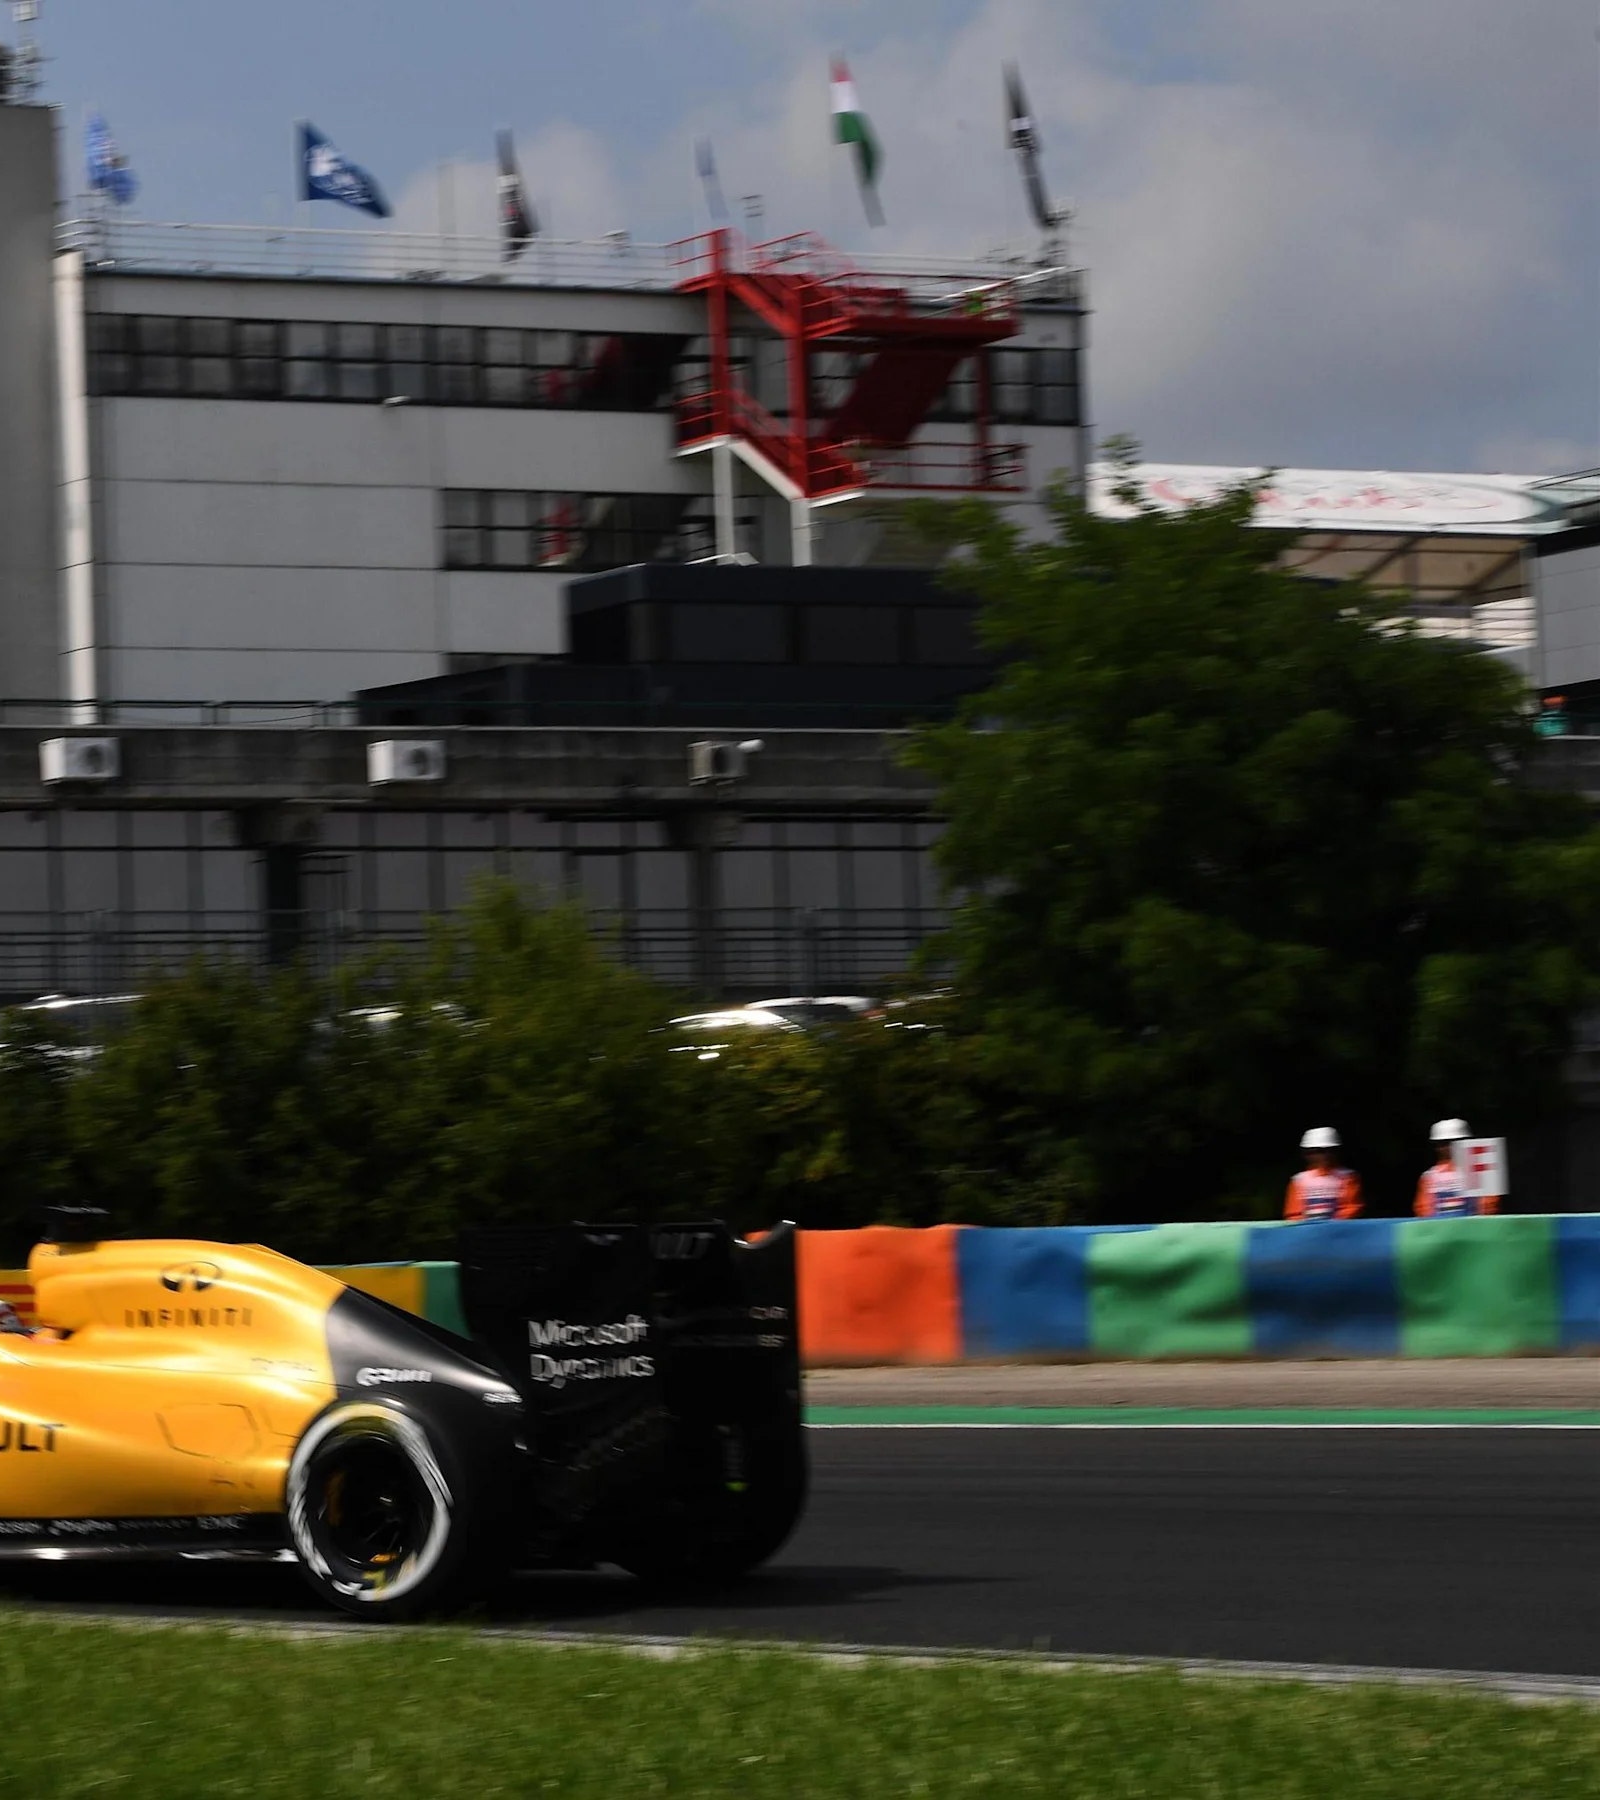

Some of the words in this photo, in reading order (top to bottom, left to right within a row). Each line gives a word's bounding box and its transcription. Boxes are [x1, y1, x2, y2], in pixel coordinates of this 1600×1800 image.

[1467, 1146, 1494, 1190] F
[124, 1307, 253, 1328] INFINITI
[528, 1313, 650, 1348] Microsoft
[530, 1353, 656, 1389] Dynamics
